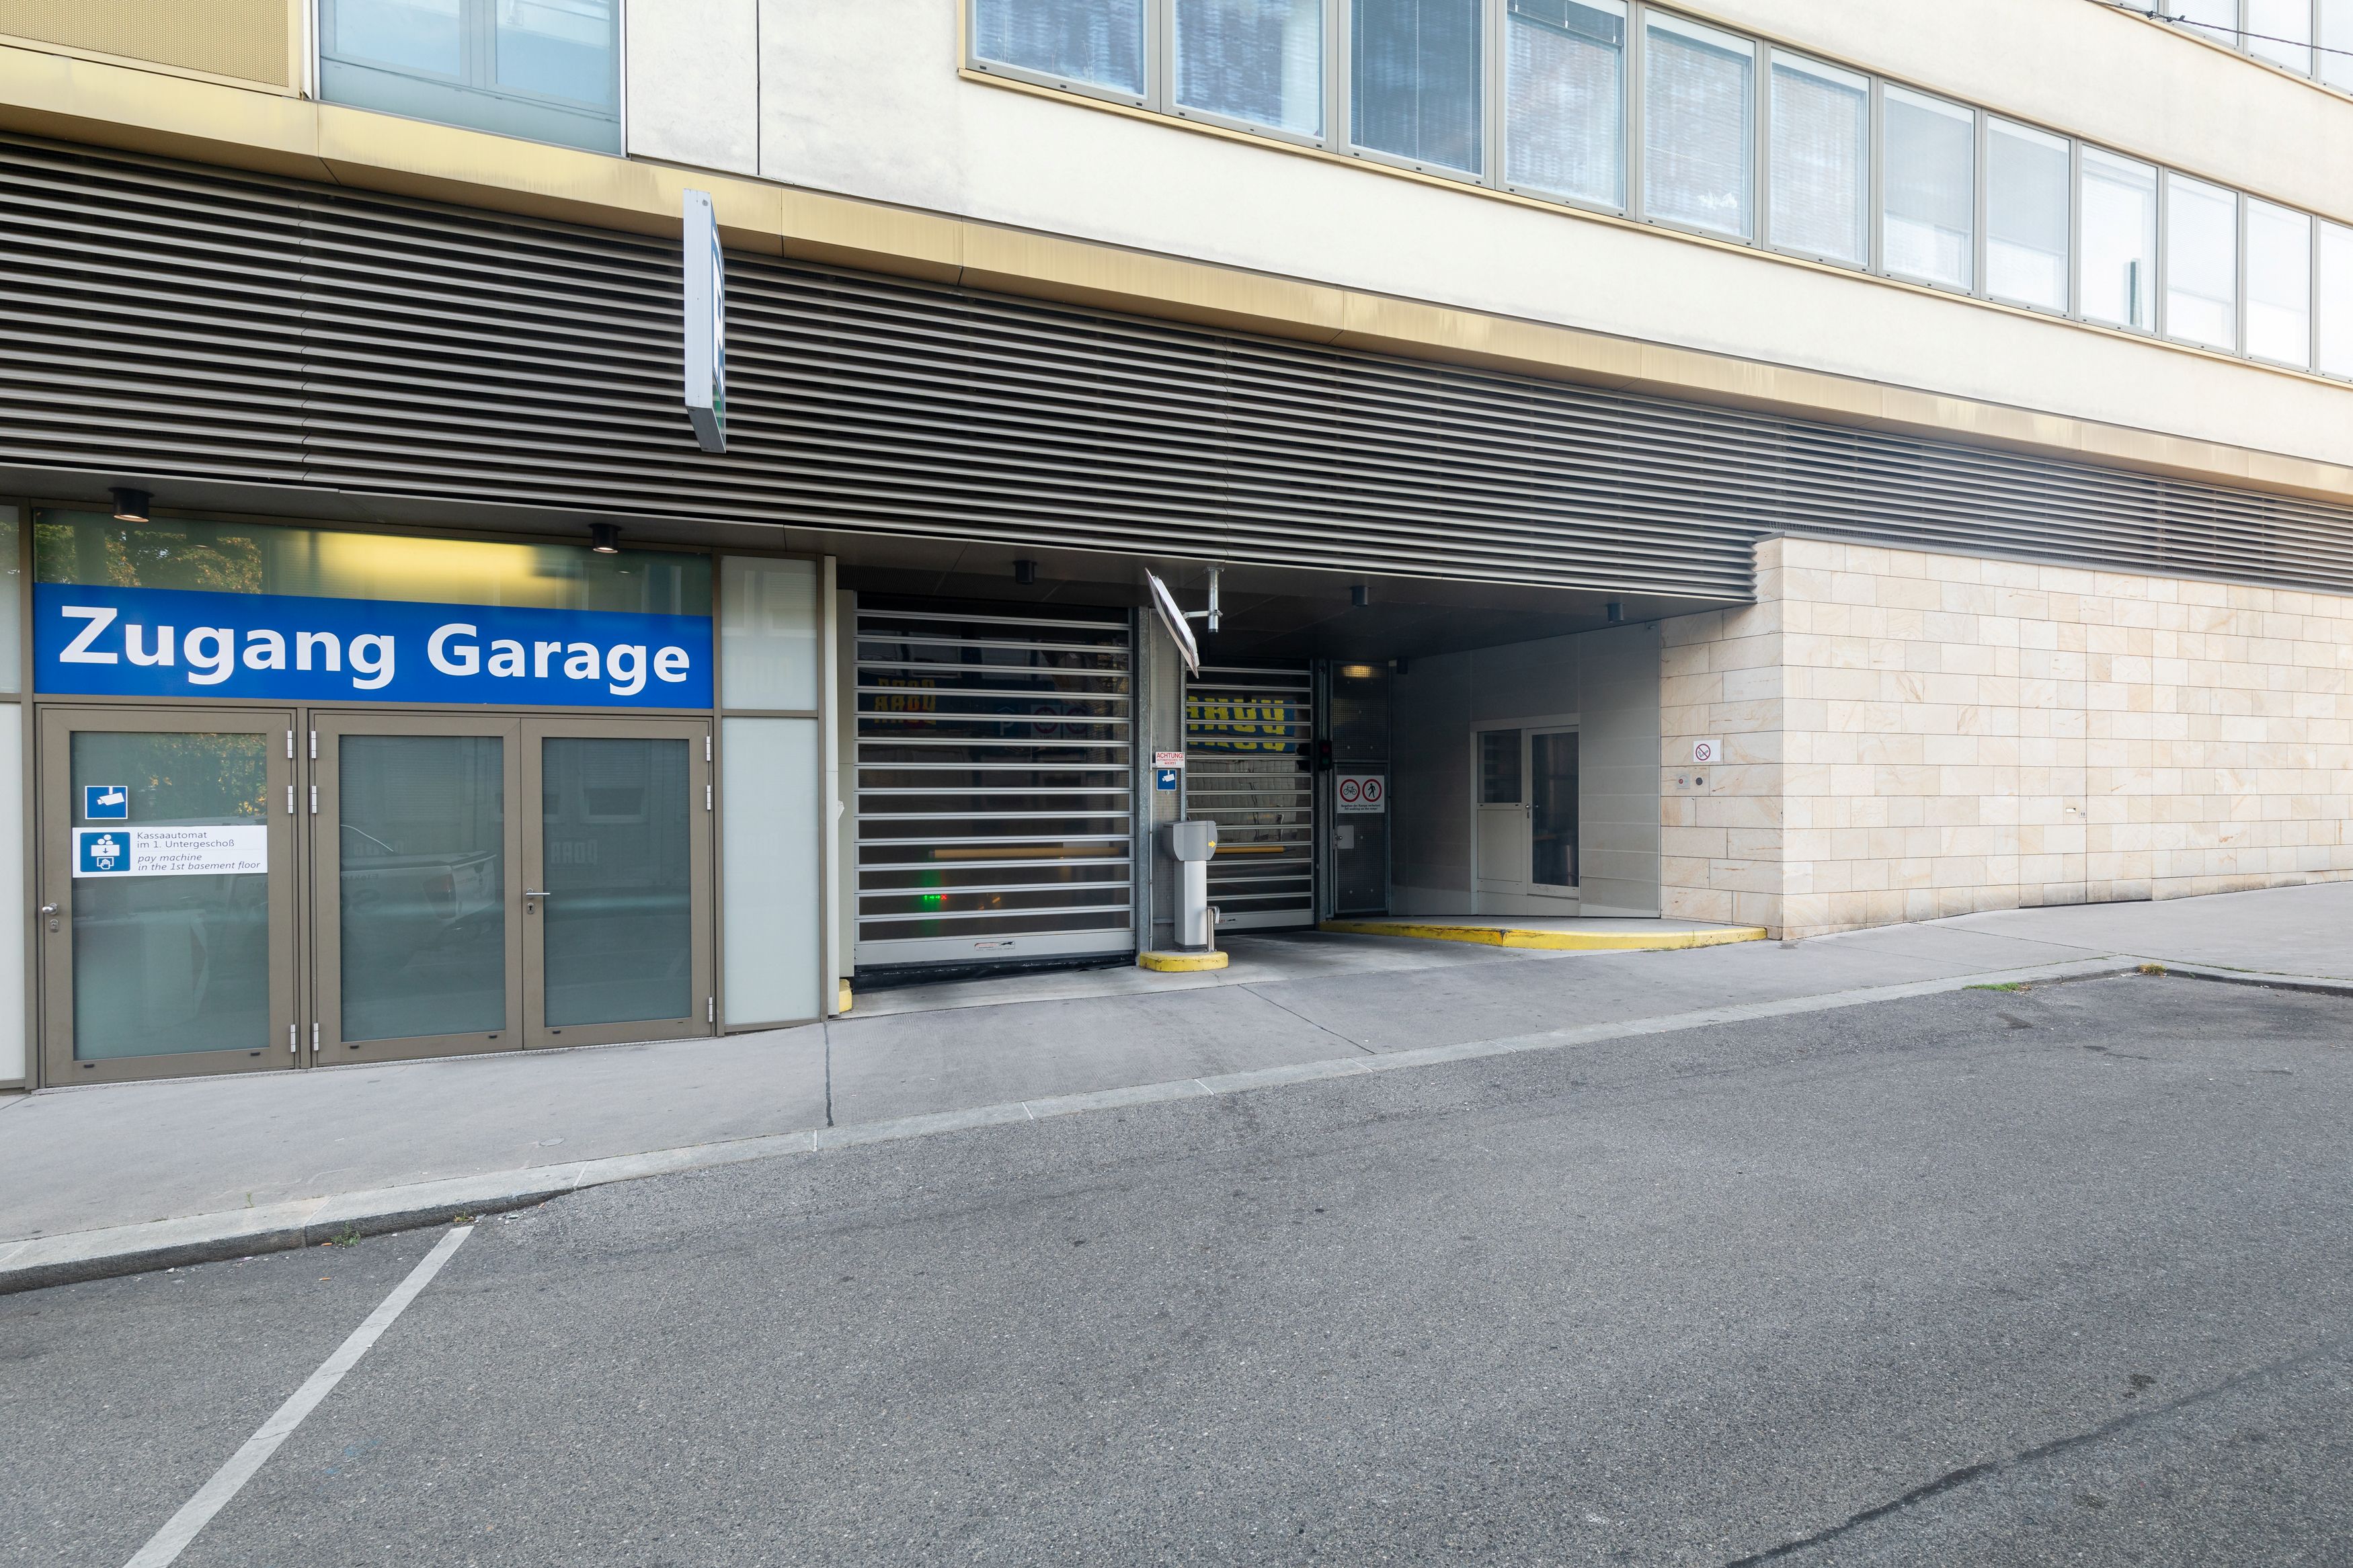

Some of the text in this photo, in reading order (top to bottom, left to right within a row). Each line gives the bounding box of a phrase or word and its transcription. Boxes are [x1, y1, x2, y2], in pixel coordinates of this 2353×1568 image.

[59, 606, 396, 690] Zugang
[426, 623, 690, 696] Garage
[137, 831, 207, 839] Kassaautomat
[137, 840, 149, 848] im
[165, 839, 235, 849] Untergeschoß
[138, 854, 202, 864] pay machine
[237, 861, 261, 870] floor
